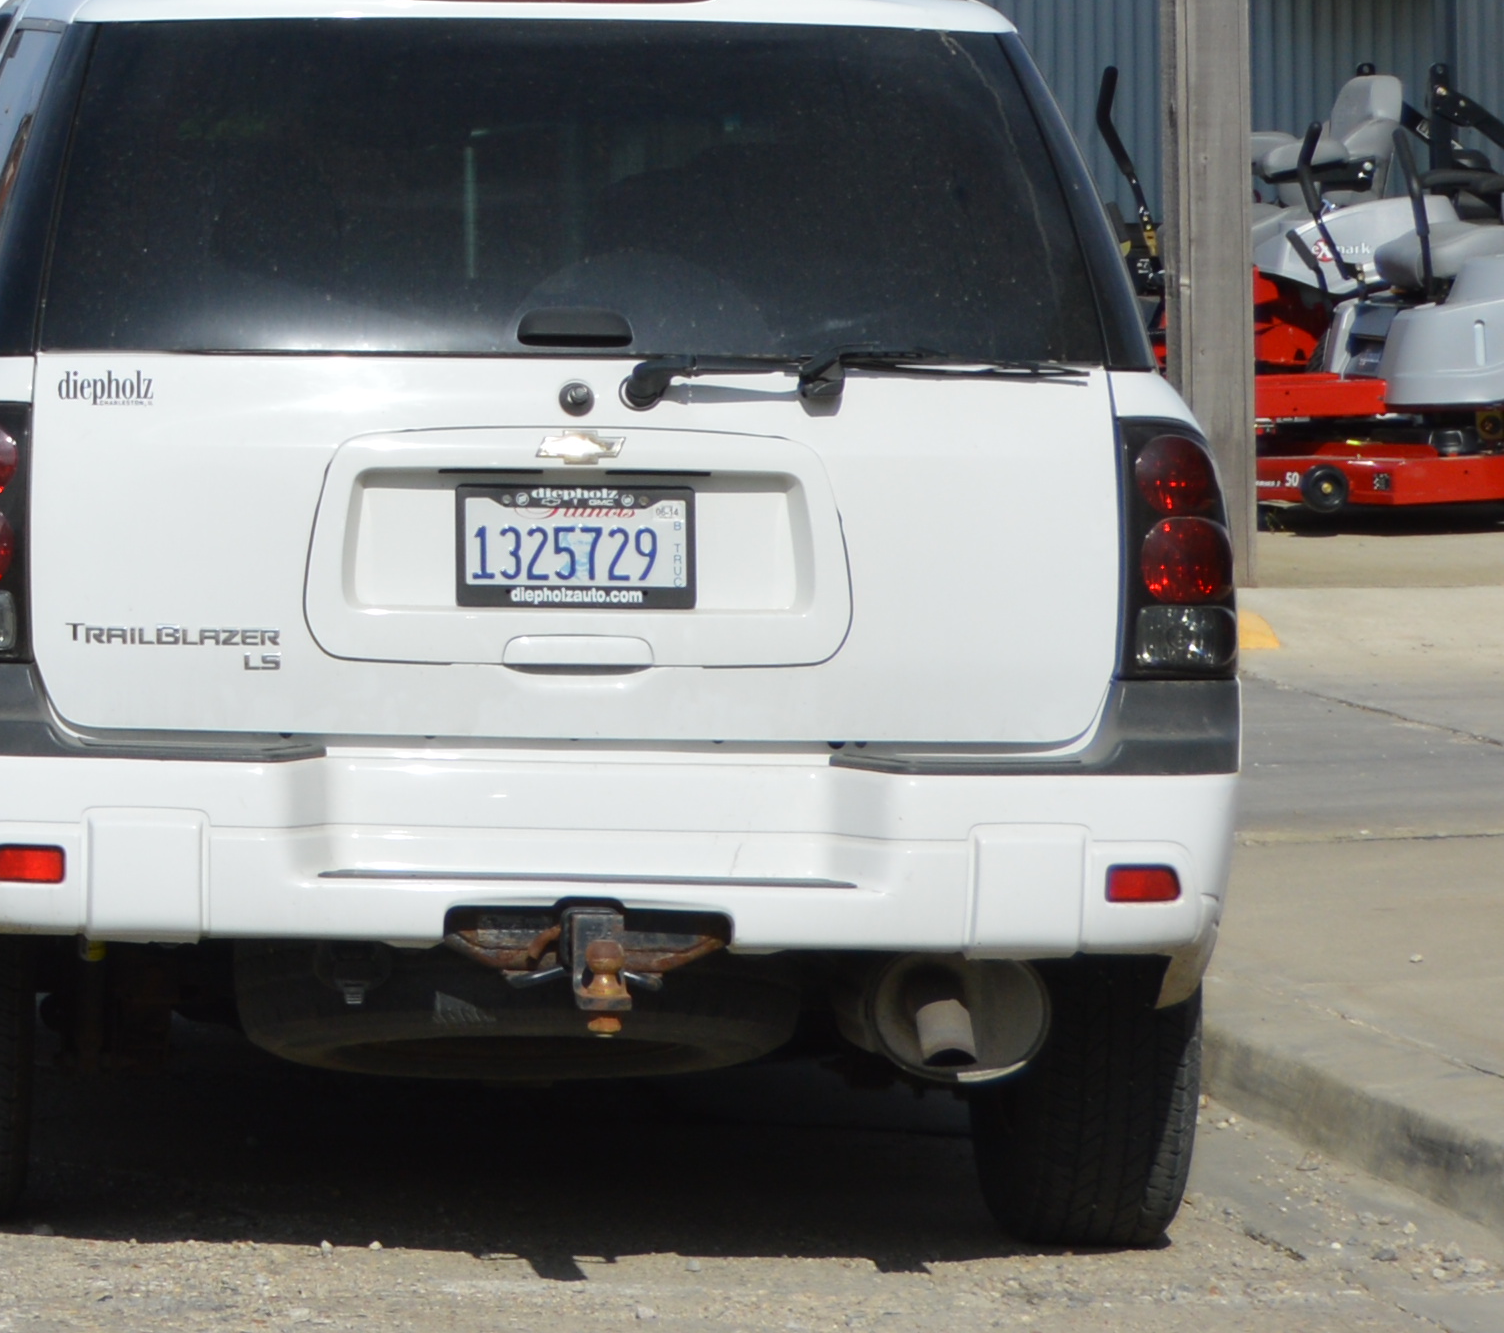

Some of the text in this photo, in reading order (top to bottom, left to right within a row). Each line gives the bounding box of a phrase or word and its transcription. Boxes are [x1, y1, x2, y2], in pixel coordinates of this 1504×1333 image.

[57, 370, 154, 405] diepholz
[1285, 471, 1300, 487] 50
[531, 488, 619, 501] diepholz
[472, 525, 657, 581] 1325729
[510, 587, 643, 604] diepholzauto.com
[243, 651, 281, 671] LS
